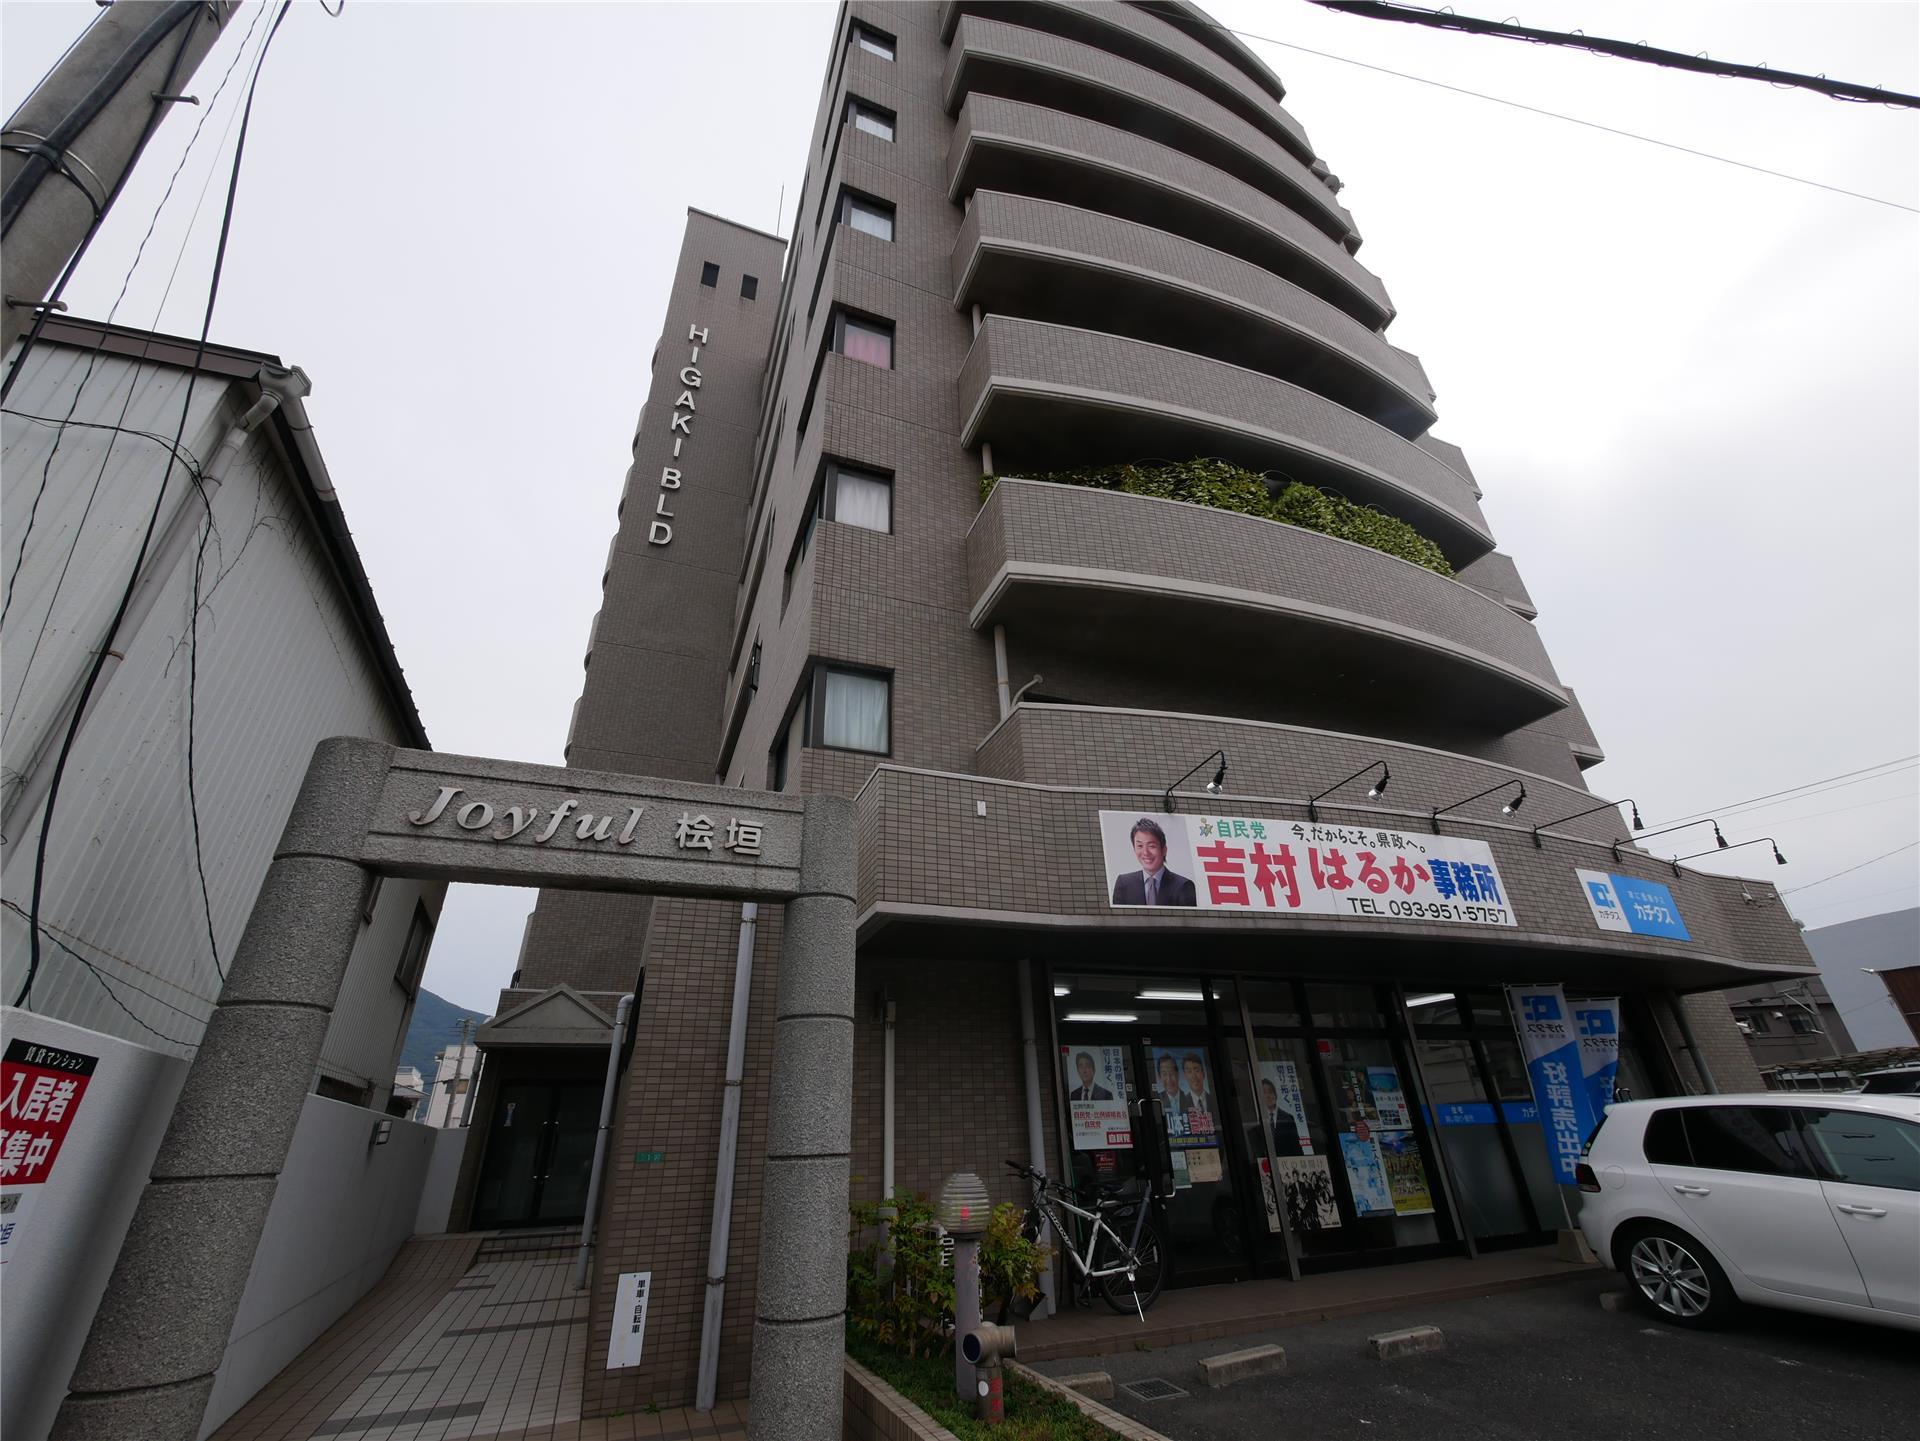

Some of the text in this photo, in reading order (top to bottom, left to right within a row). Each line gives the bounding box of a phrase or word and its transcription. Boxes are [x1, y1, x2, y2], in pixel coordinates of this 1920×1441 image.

[648, 323, 709, 546] HIGAKI BLD
[408, 786, 764, 857] Joyful 桧垣
[1217, 819, 1267, 840] 自民党
[1197, 840, 1504, 909] 吉村 はるか 事務所
[1347, 897, 1508, 925] TEL 093-951-5757
[1598, 910, 1622, 921] カチタス
[1633, 902, 1675, 925] カチタス
[23, 1045, 85, 1071] 賃貸マンション
[0, 1071, 79, 1124] 入居者
[631, 1279, 646, 1334] 単車・自転車
